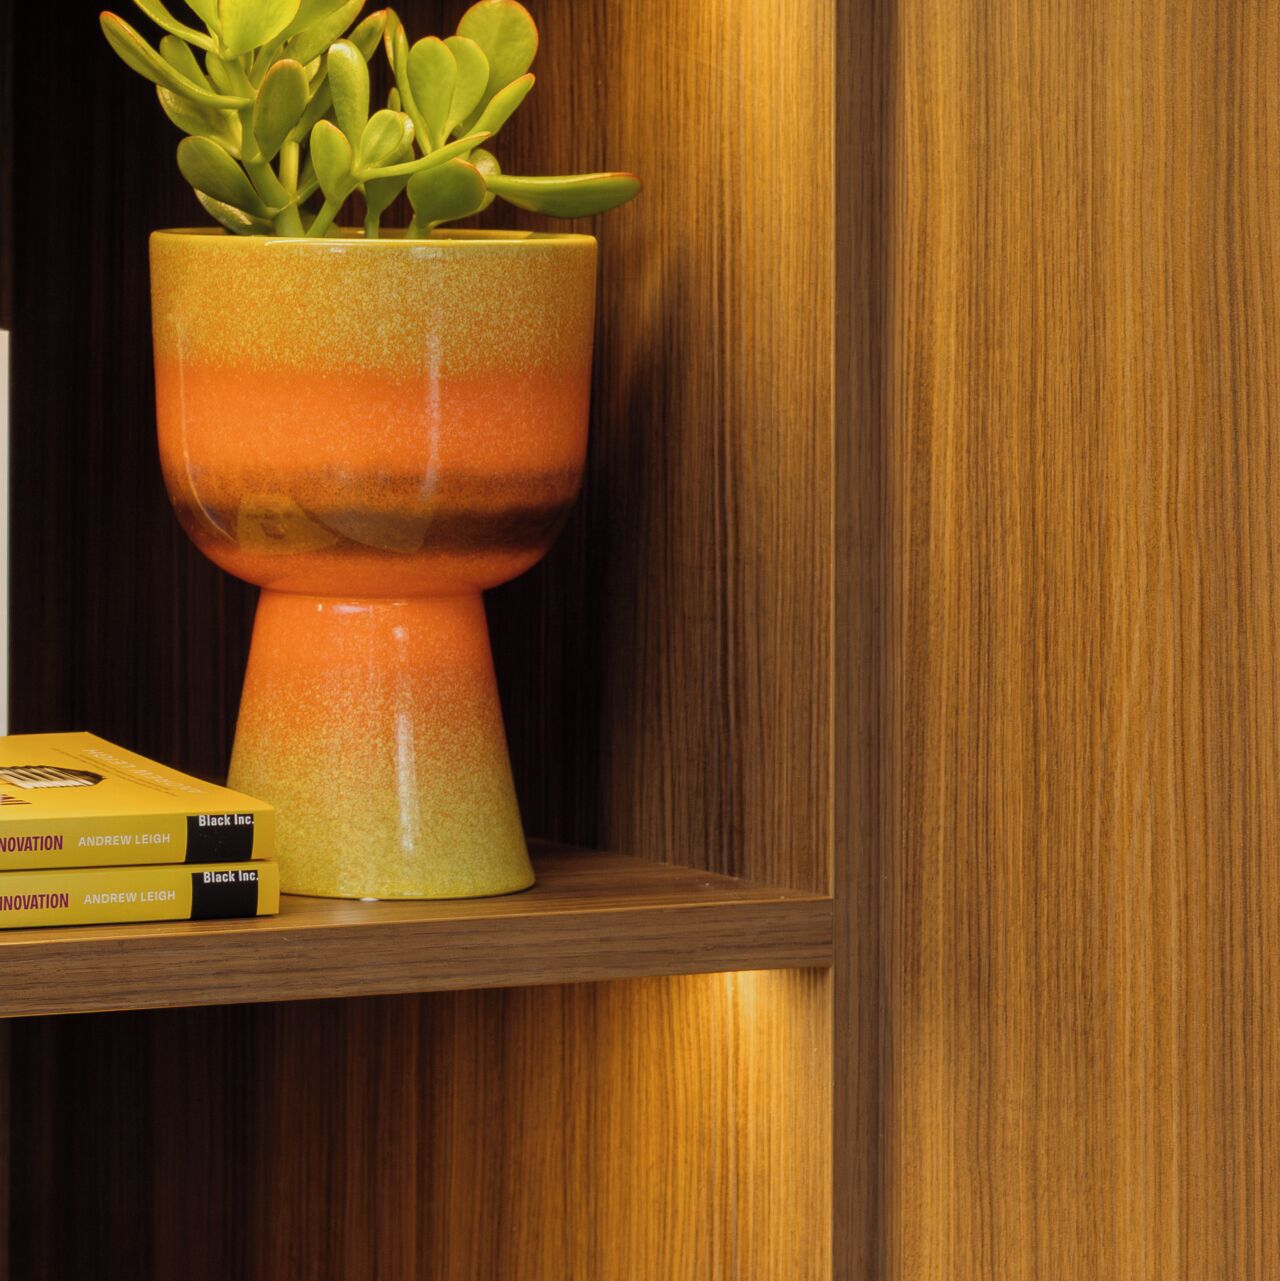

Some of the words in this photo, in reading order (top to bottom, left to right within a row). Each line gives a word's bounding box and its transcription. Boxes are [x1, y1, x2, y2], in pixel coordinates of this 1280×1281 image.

[198, 814, 231, 827] Black
[234, 813, 255, 825] Inc.
[78, 835, 132, 847] ANDREW
[134, 833, 171, 845] LEIGH
[203, 870, 236, 884] Black
[238, 869, 259, 882] Inc.
[83, 892, 137, 905] ANDREW
[140, 890, 176, 903] LEIGH
